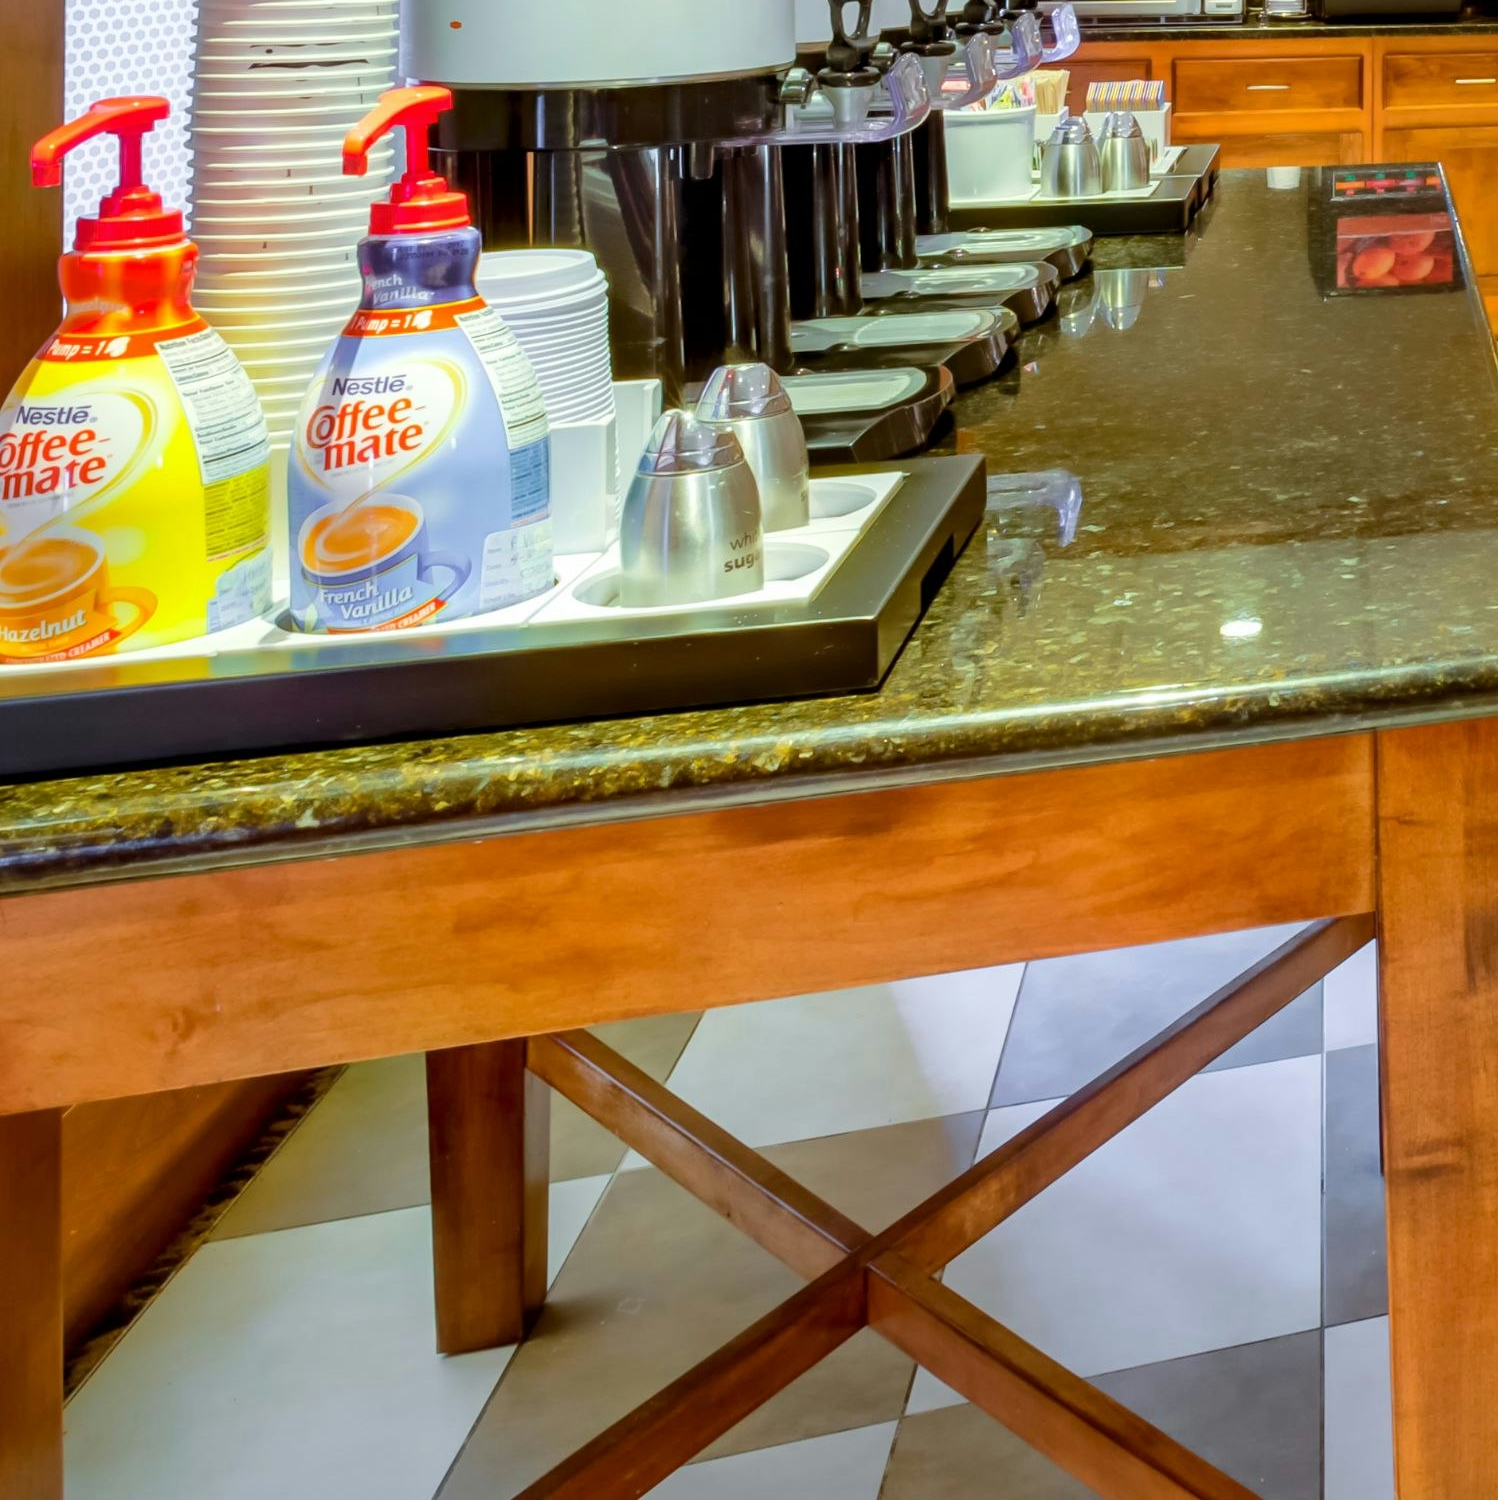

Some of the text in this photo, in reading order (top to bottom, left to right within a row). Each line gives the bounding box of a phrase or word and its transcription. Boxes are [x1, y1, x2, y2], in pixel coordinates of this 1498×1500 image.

[372, 286, 430, 306] Vanilla
[356, 315, 389, 334] Pump
[404, 314, 413, 329] 1
[95, 339, 107, 356] 1
[323, 421, 424, 471] mate
[2, 456, 107, 500] mate
[319, 581, 379, 605] French
[340, 585, 414, 619] Vanilla
[0, 609, 87, 643] Hazelnut
[68, 631, 111, 658] CREAMER
